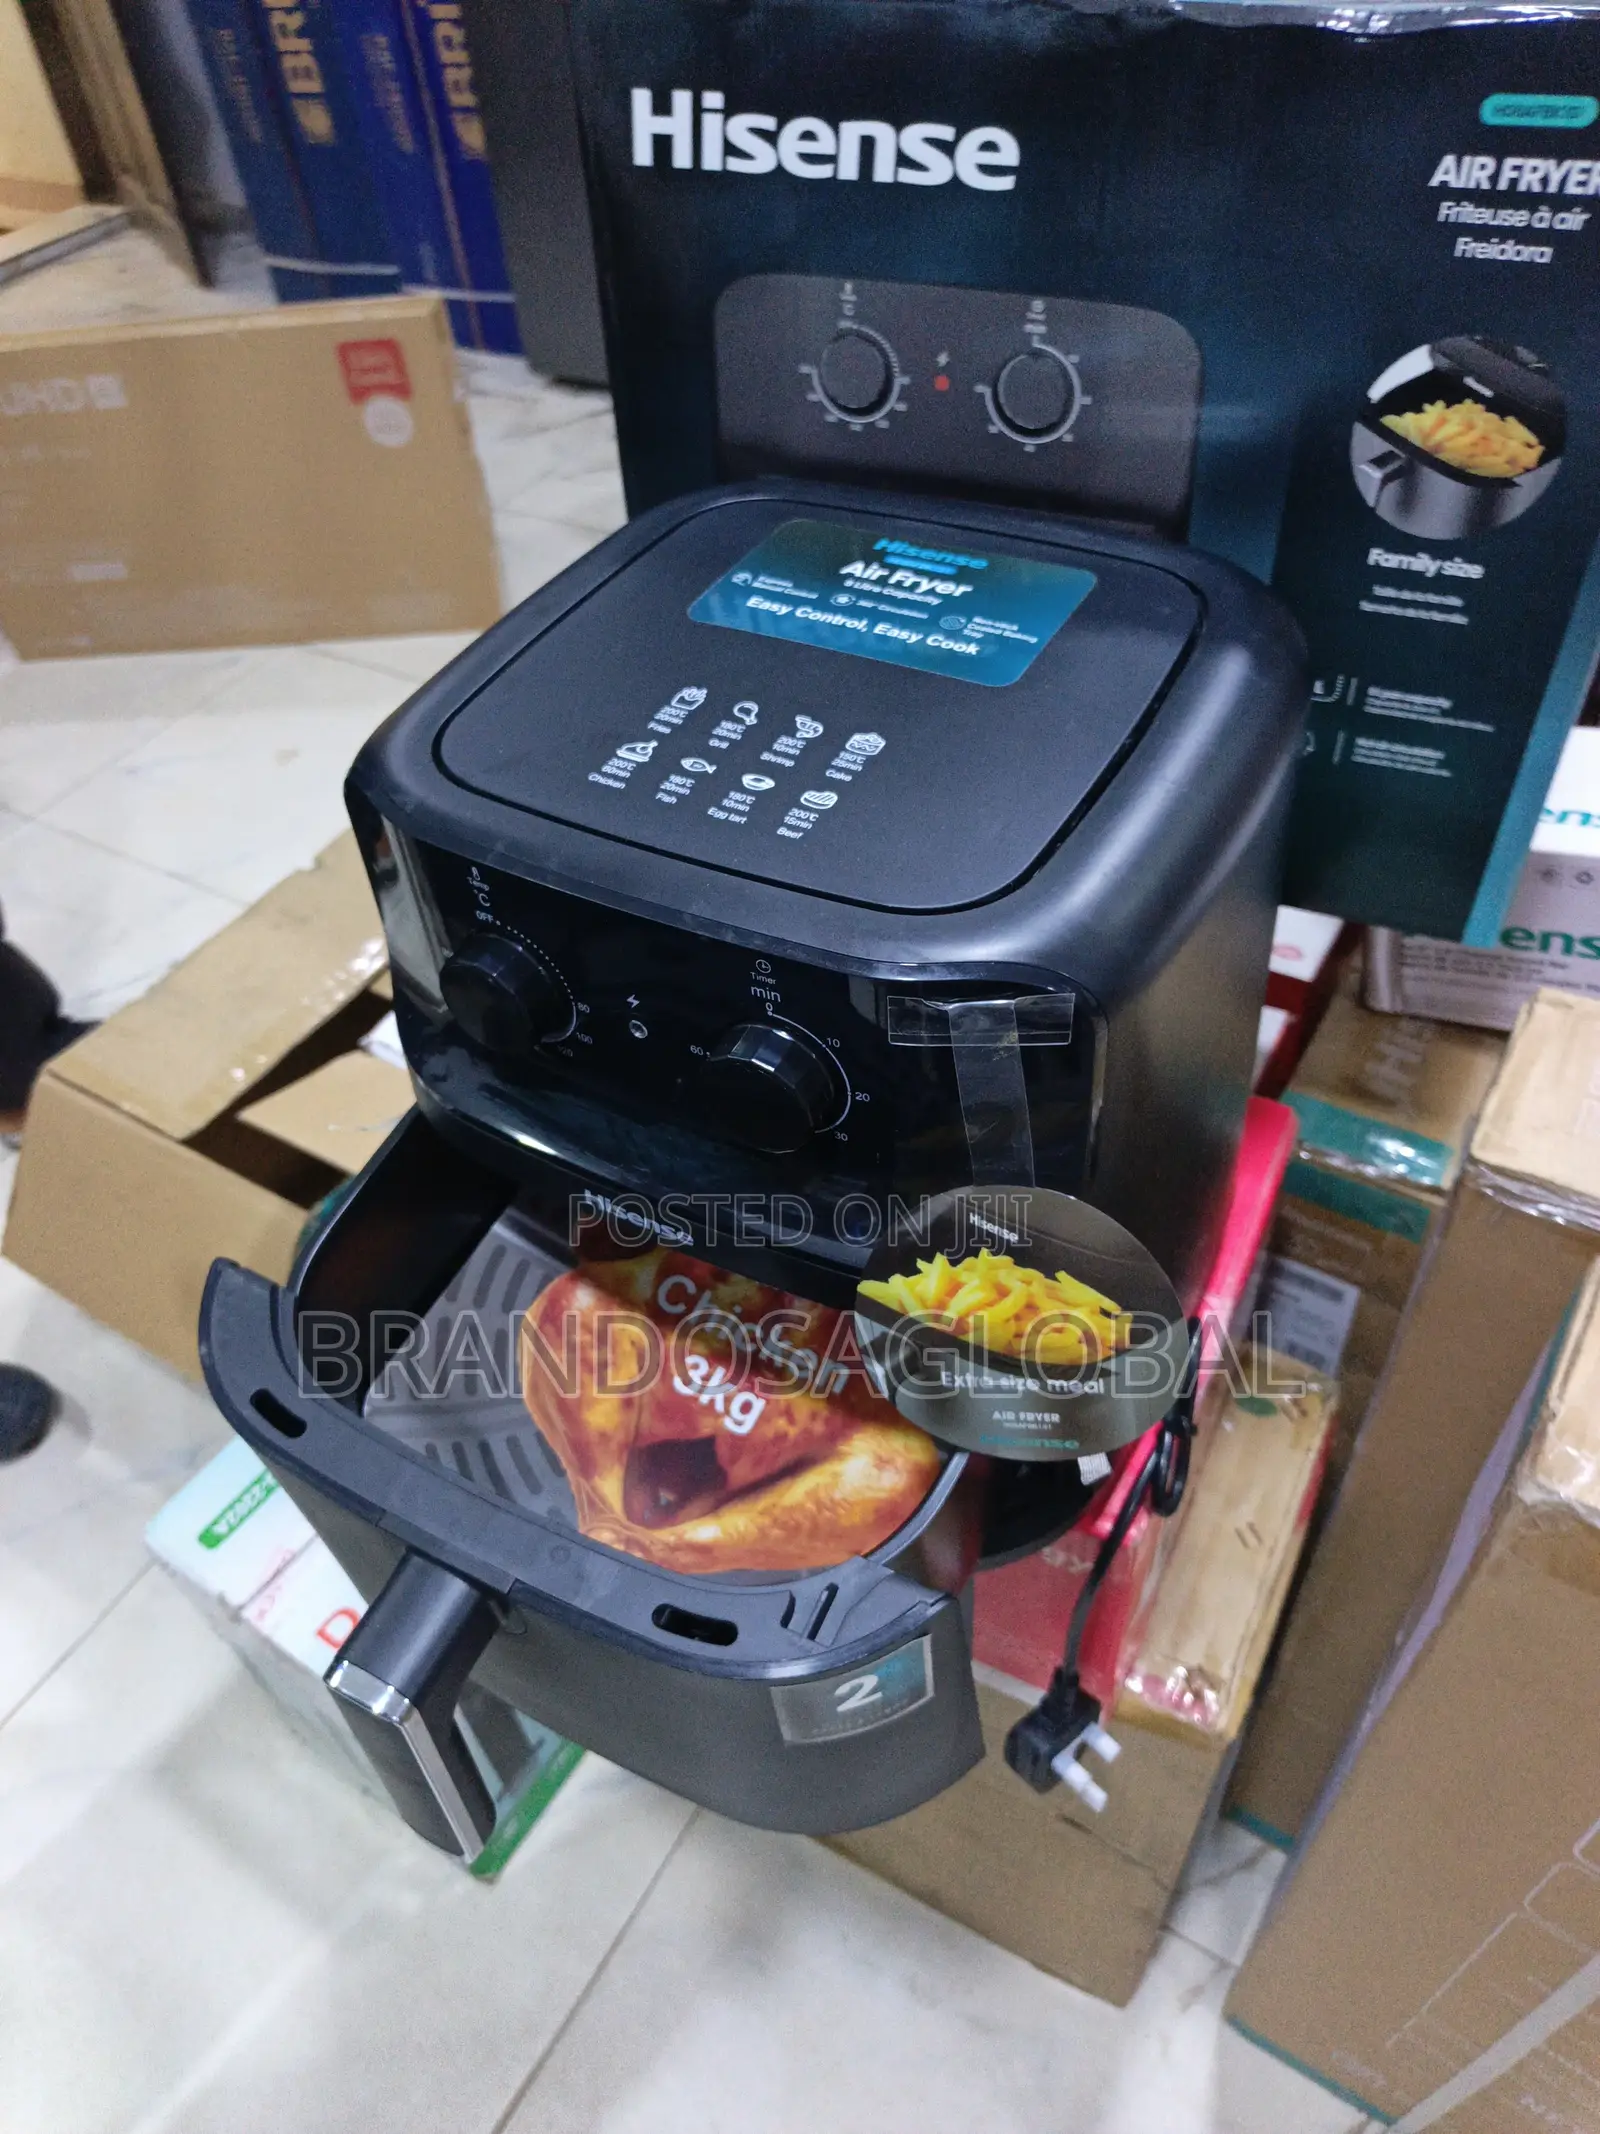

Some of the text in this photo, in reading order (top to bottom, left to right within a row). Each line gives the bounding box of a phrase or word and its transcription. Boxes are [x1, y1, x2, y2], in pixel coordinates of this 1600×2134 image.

[630, 87, 1021, 191] Hisense
[1427, 154, 1497, 190] AIR
[1552, 207, 1592, 231] air
[1453, 237, 1554, 263] Freidora
[873, 537, 989, 569] Hisense
[1367, 547, 1485, 579] Family size
[839, 560, 890, 581] Air
[887, 569, 974, 597] Fryer
[882, 586, 943, 606] Capacity
[746, 594, 980, 656] Easy Control, Easy Cook
[647, 721, 672, 734] Fries
[708, 737, 731, 749] Grill
[760, 751, 795, 767] Shrimp
[588, 772, 626, 789] Chicken
[825, 769, 852, 782] Cake
[655, 791, 677, 804] Fish
[707, 806, 747, 825] Egg tart
[776, 826, 804, 839] Beef
[475, 910, 494, 923] OFF
[750, 971, 776, 985] Timer
[751, 985, 781, 1002] min
[765, 1002, 773, 1012] 0
[690, 1045, 704, 1056] 60
[827, 1037, 841, 1048] 10
[855, 1092, 871, 1102] 20
[834, 1131, 849, 1142] 30
[584, 1188, 694, 1246] Hisense
[969, 1212, 1019, 1243] Hisense
[657, 1274, 850, 1394] Chicken
[940, 1371, 999, 1391] Extra
[1046, 1377, 1105, 1395] meal
[673, 1354, 766, 1435] 3kg
[834, 1674, 883, 1712] 2
